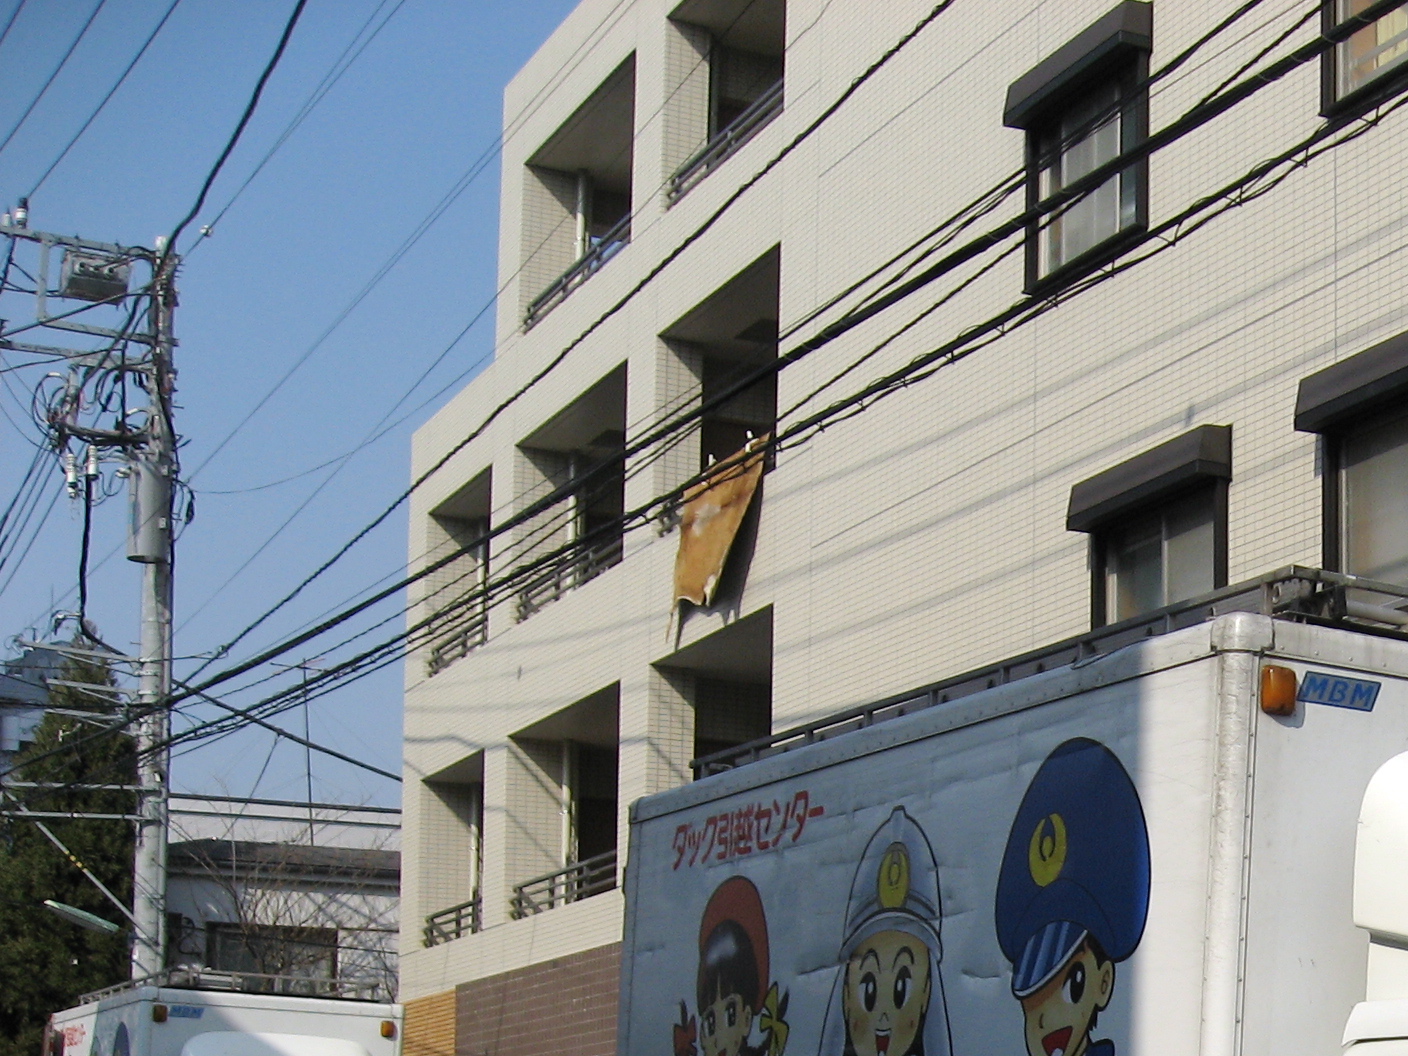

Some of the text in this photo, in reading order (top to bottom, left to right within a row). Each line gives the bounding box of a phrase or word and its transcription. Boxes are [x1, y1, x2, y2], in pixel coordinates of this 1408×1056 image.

[1304, 676, 1375, 706] MBM
[672, 790, 825, 871] ダック引越センター
